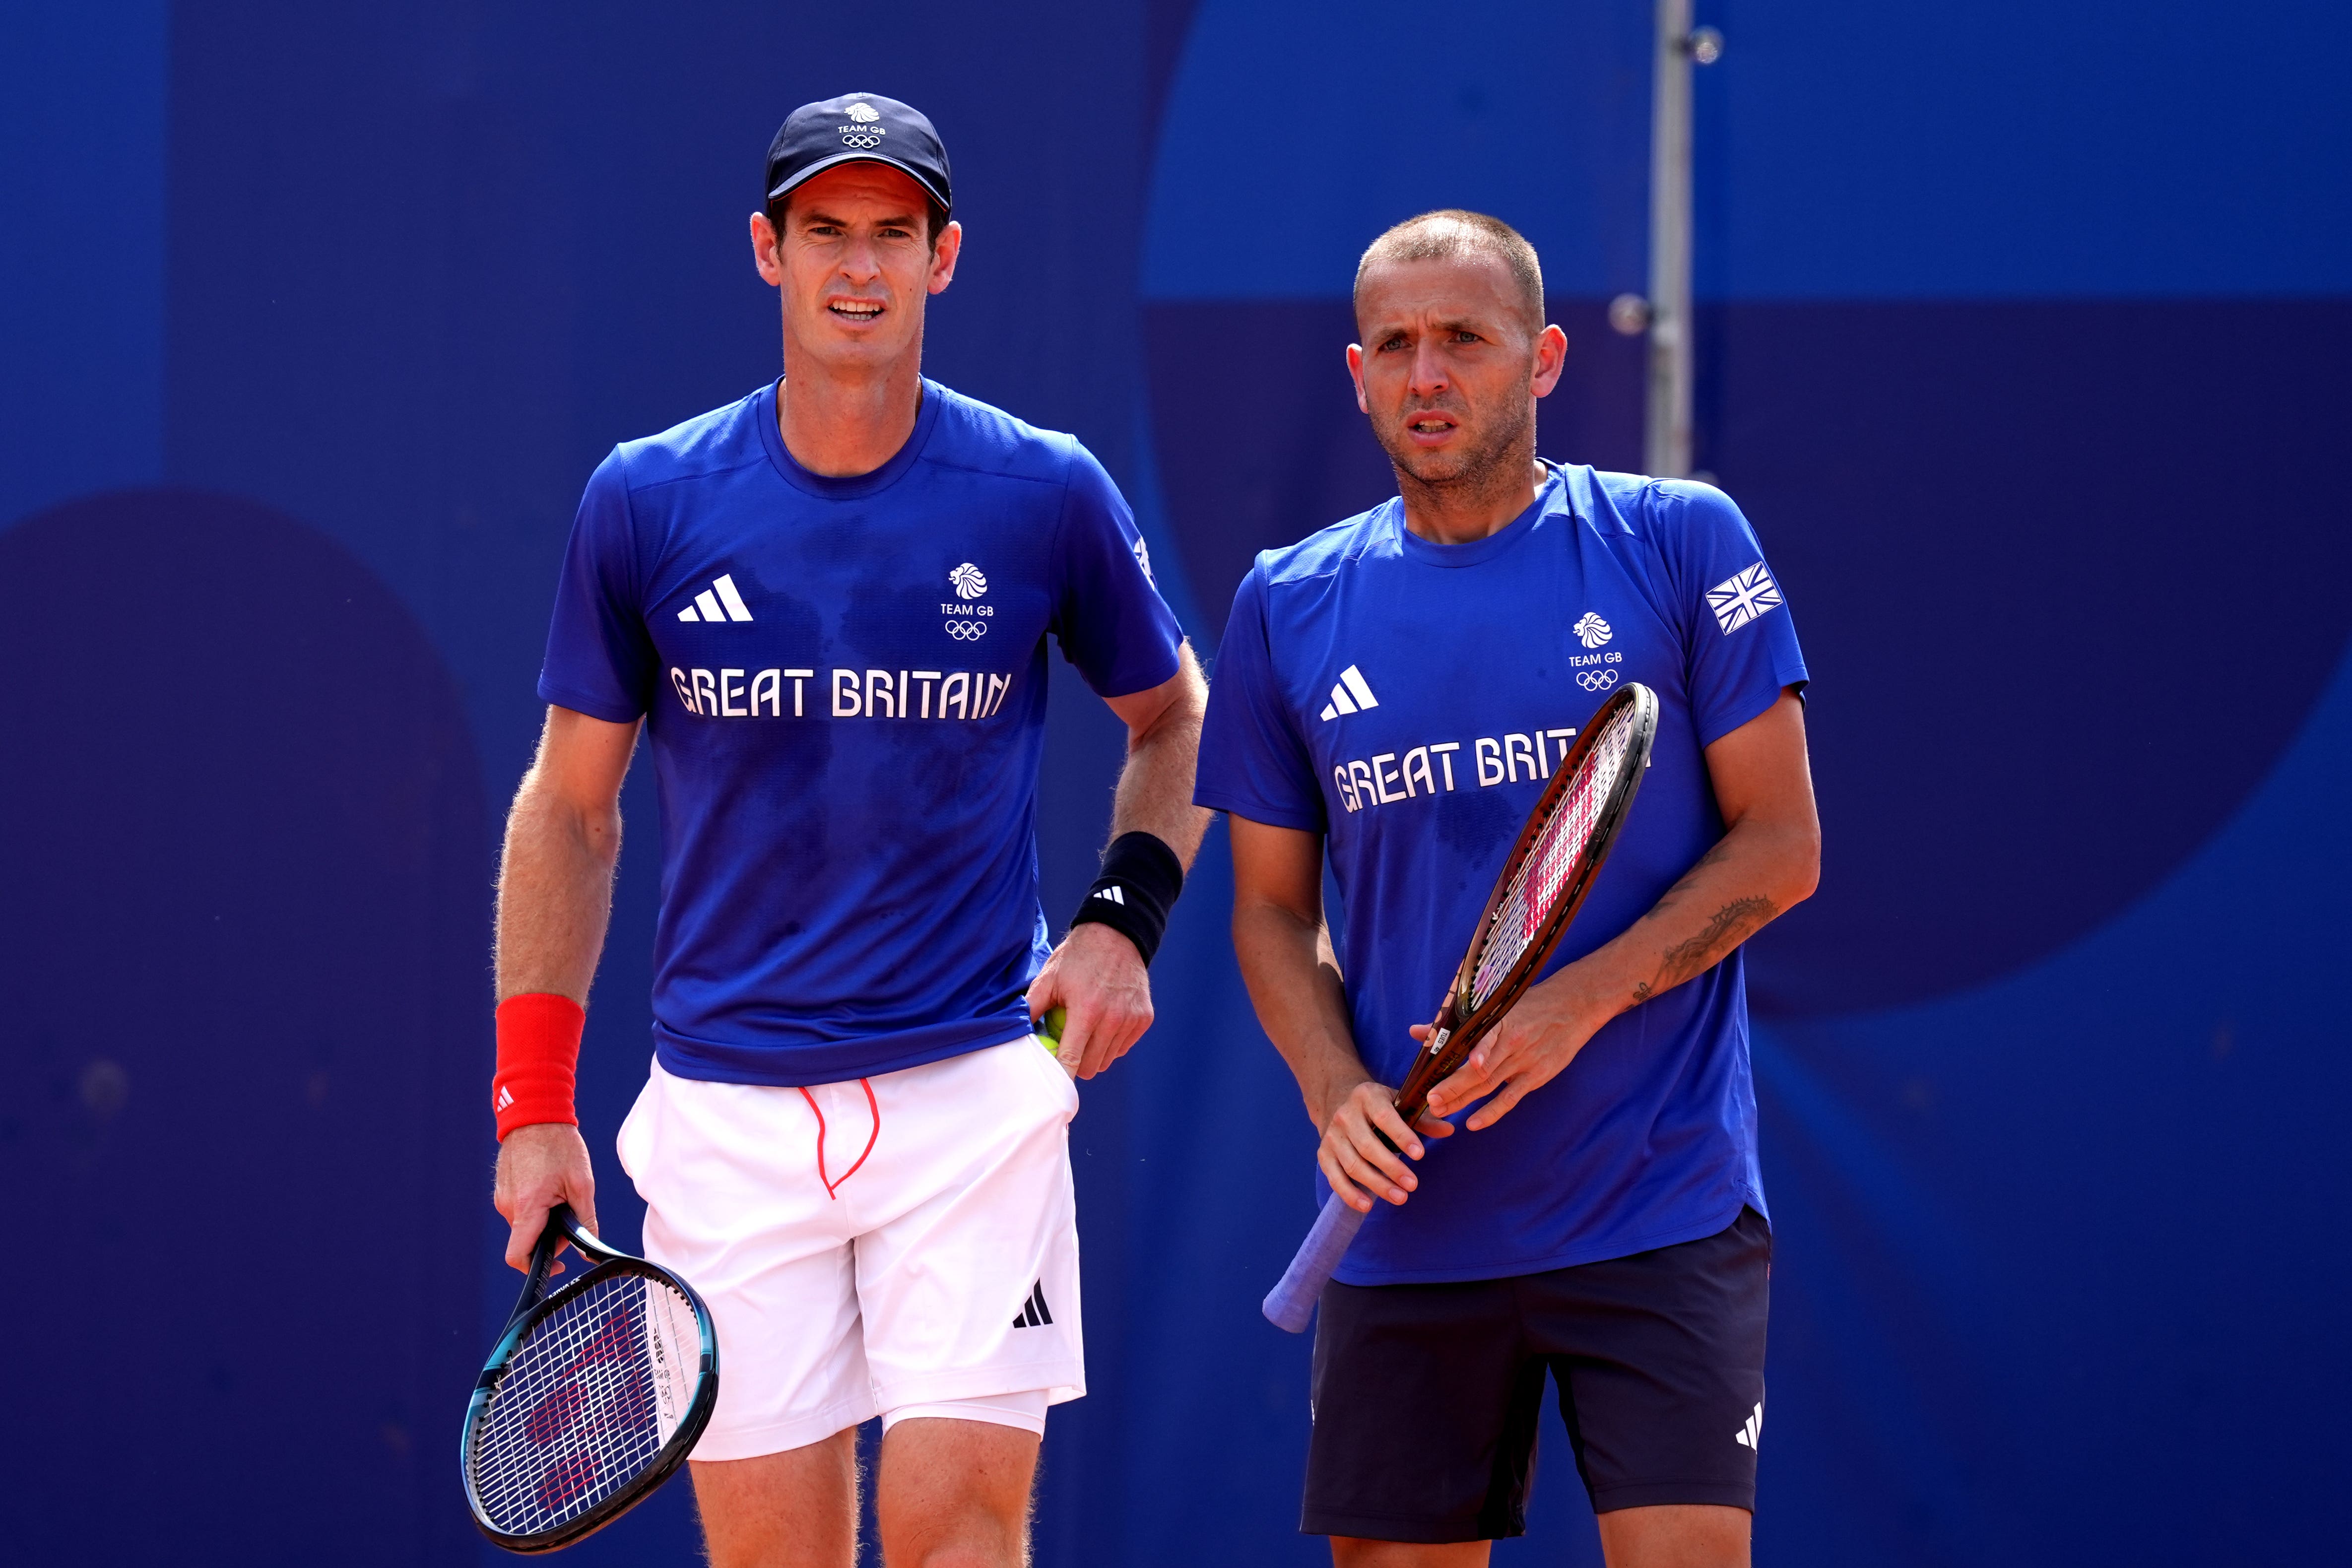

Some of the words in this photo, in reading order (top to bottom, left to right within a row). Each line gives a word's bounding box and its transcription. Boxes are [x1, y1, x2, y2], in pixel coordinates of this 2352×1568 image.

[838, 125, 867, 133] TEAM
[870, 126, 886, 135] GB
[941, 604, 973, 616] TEAM
[977, 606, 994, 616] GB
[1569, 653, 1601, 667] TEAM
[1605, 652, 1623, 663] GB
[671, 667, 814, 717] GREAT
[832, 669, 1011, 719] BRITAIN
[1334, 742, 1460, 813] GREAT
[1437, 1032, 1448, 1045] TUES
